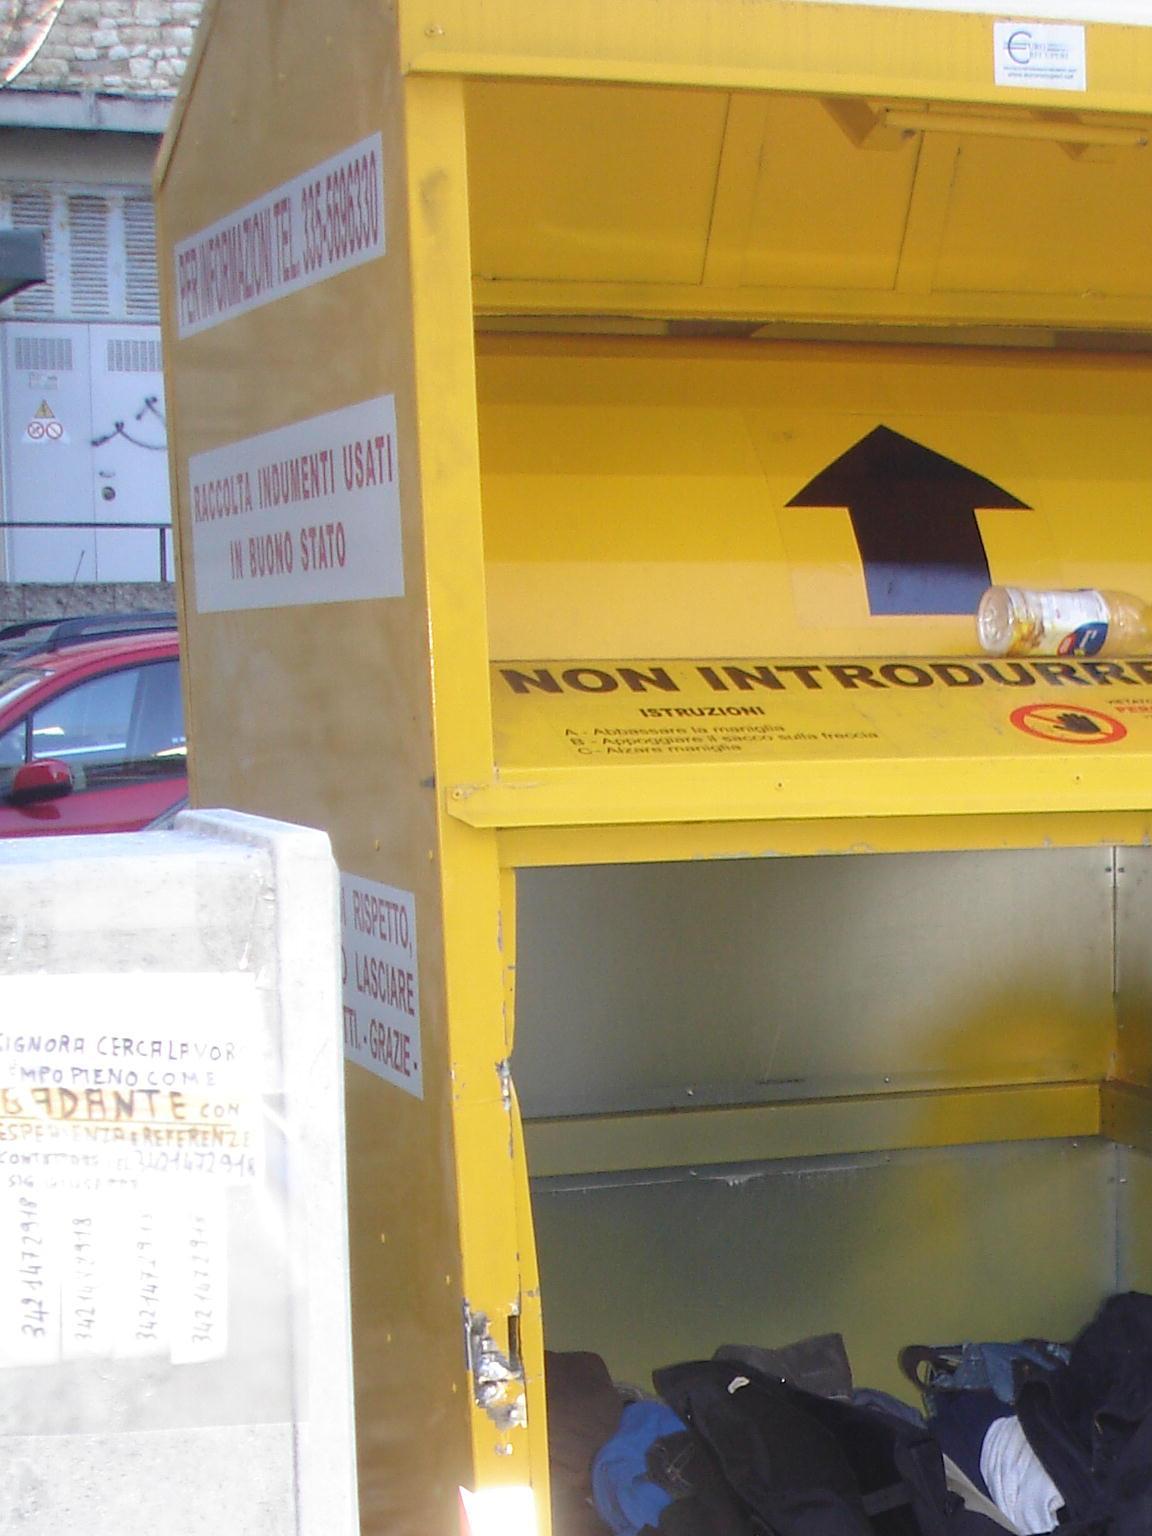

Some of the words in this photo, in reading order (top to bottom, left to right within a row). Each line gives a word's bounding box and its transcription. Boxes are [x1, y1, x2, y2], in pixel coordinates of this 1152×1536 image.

[193, 472, 252, 523] RACCOLTA
[257, 449, 335, 509] INDUMENTI
[342, 434, 393, 491] USATI
[230, 539, 244, 580] IN
[249, 531, 294, 578] BUONO
[300, 522, 346, 571] STATO
[499, 666, 681, 694] NON
[640, 705, 765, 718] ISTRUZIONI
[354, 951, 415, 1017] LASCIARE
